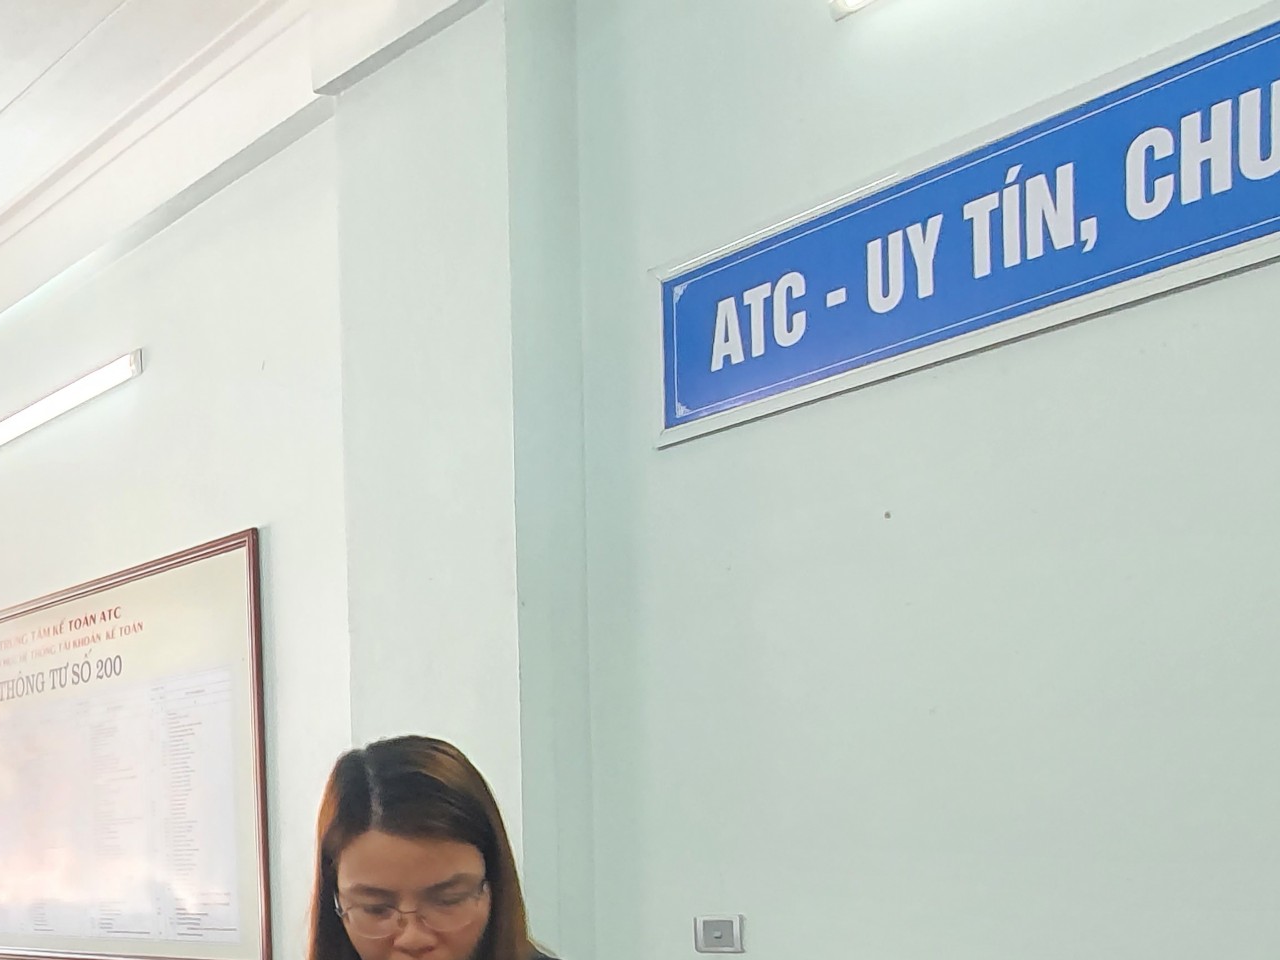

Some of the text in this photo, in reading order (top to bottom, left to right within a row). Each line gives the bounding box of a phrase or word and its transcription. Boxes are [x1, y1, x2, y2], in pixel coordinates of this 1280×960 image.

[711, 271, 806, 372] ATC
[866, 213, 944, 315] UY
[963, 164, 1098, 280] TÍN,
[68, 612, 97, 632] TOÁN
[99, 606, 122, 623] ATC
[49, 661, 69, 690] TƯ
[71, 648, 93, 685] SỐ
[96, 655, 123, 680] 200
